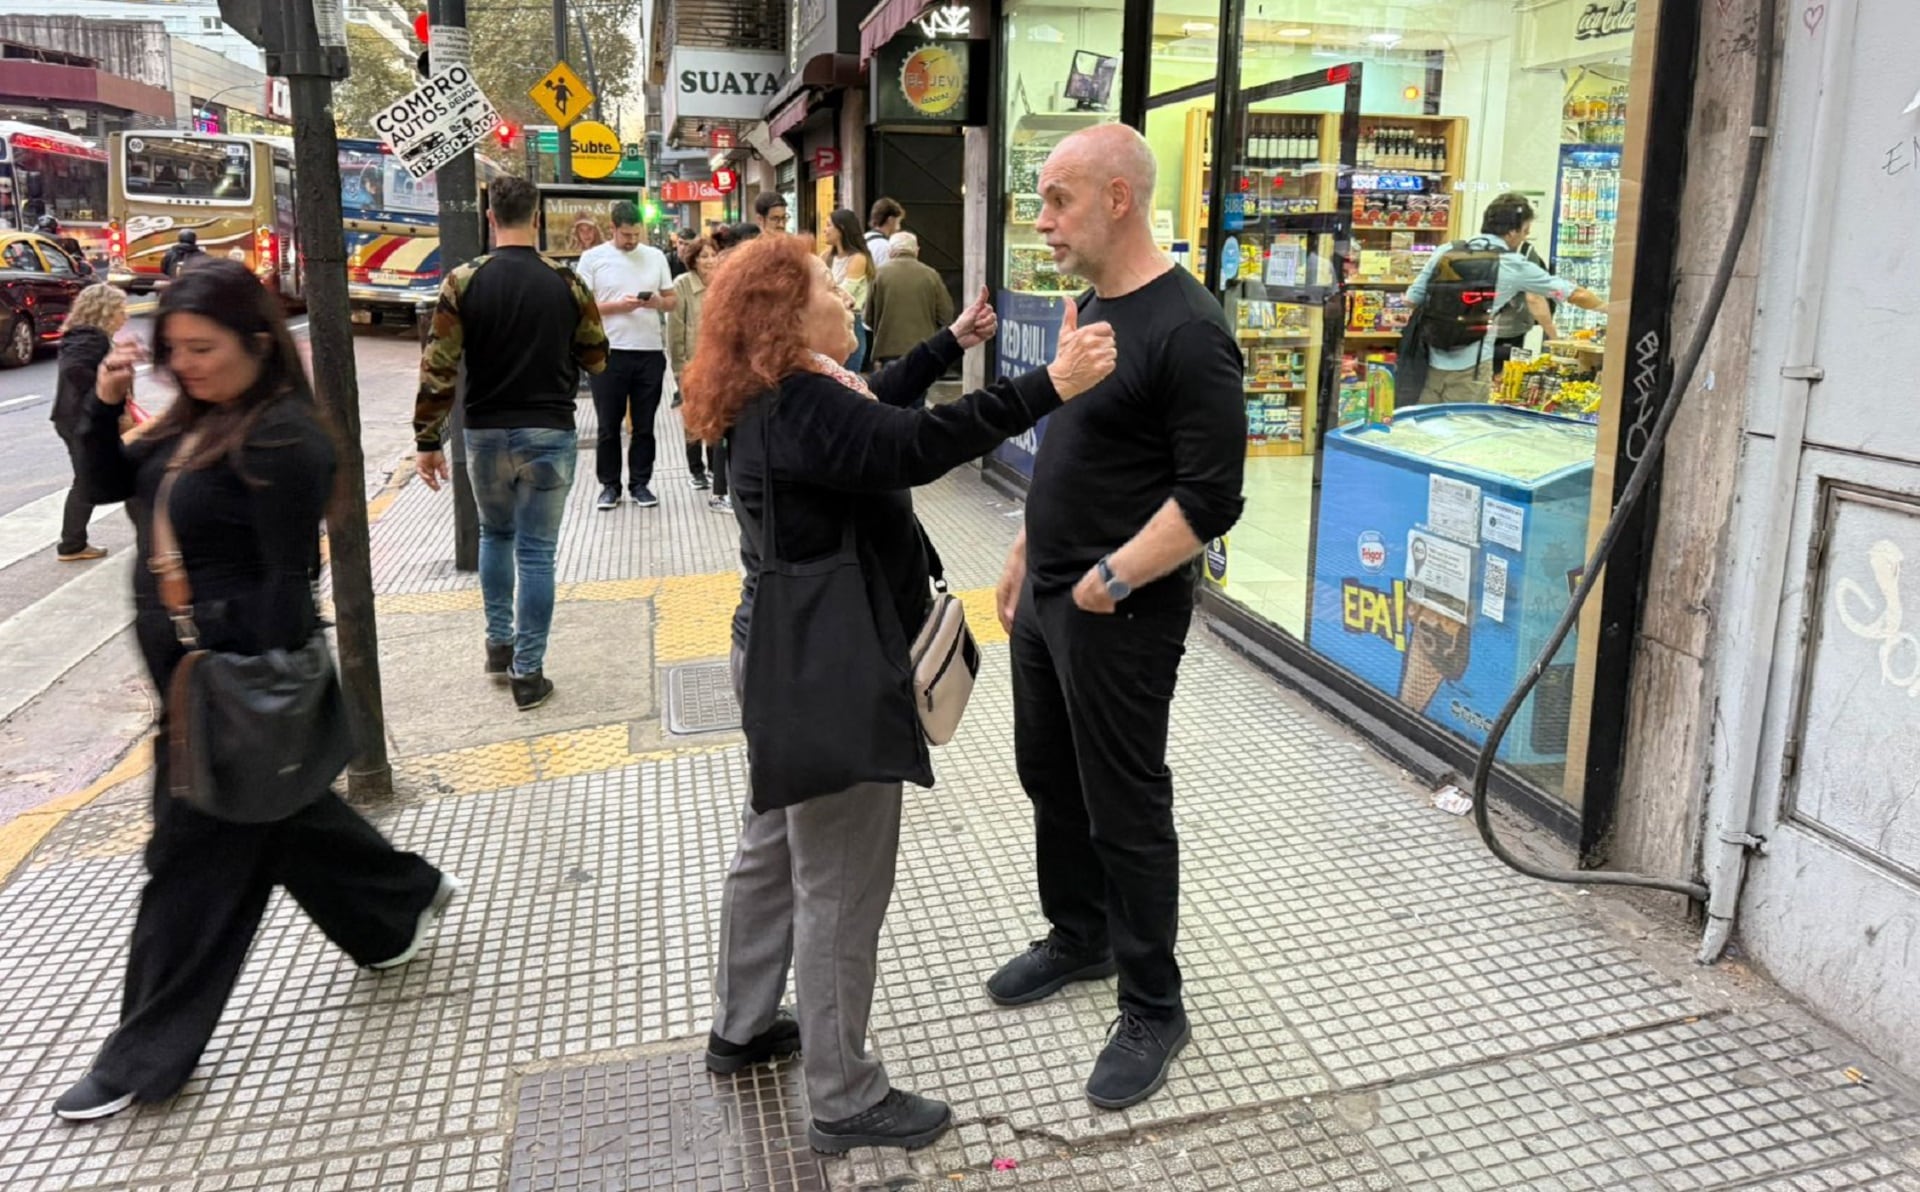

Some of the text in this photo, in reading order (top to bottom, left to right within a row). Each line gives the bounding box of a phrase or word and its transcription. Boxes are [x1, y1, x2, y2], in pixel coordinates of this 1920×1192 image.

[376, 67, 467, 132] COMPRO
[448, 87, 478, 109] DEUDA
[681, 69, 780, 95] SUAYA
[392, 102, 448, 147] AUTOS
[410, 113, 499, 178] 11-3590-3002
[571, 140, 613, 154] Subte
[1002, 319, 1047, 366] RED BULL
[1361, 547, 1383, 564] Frigor
[1343, 579, 1406, 652] EPA!
